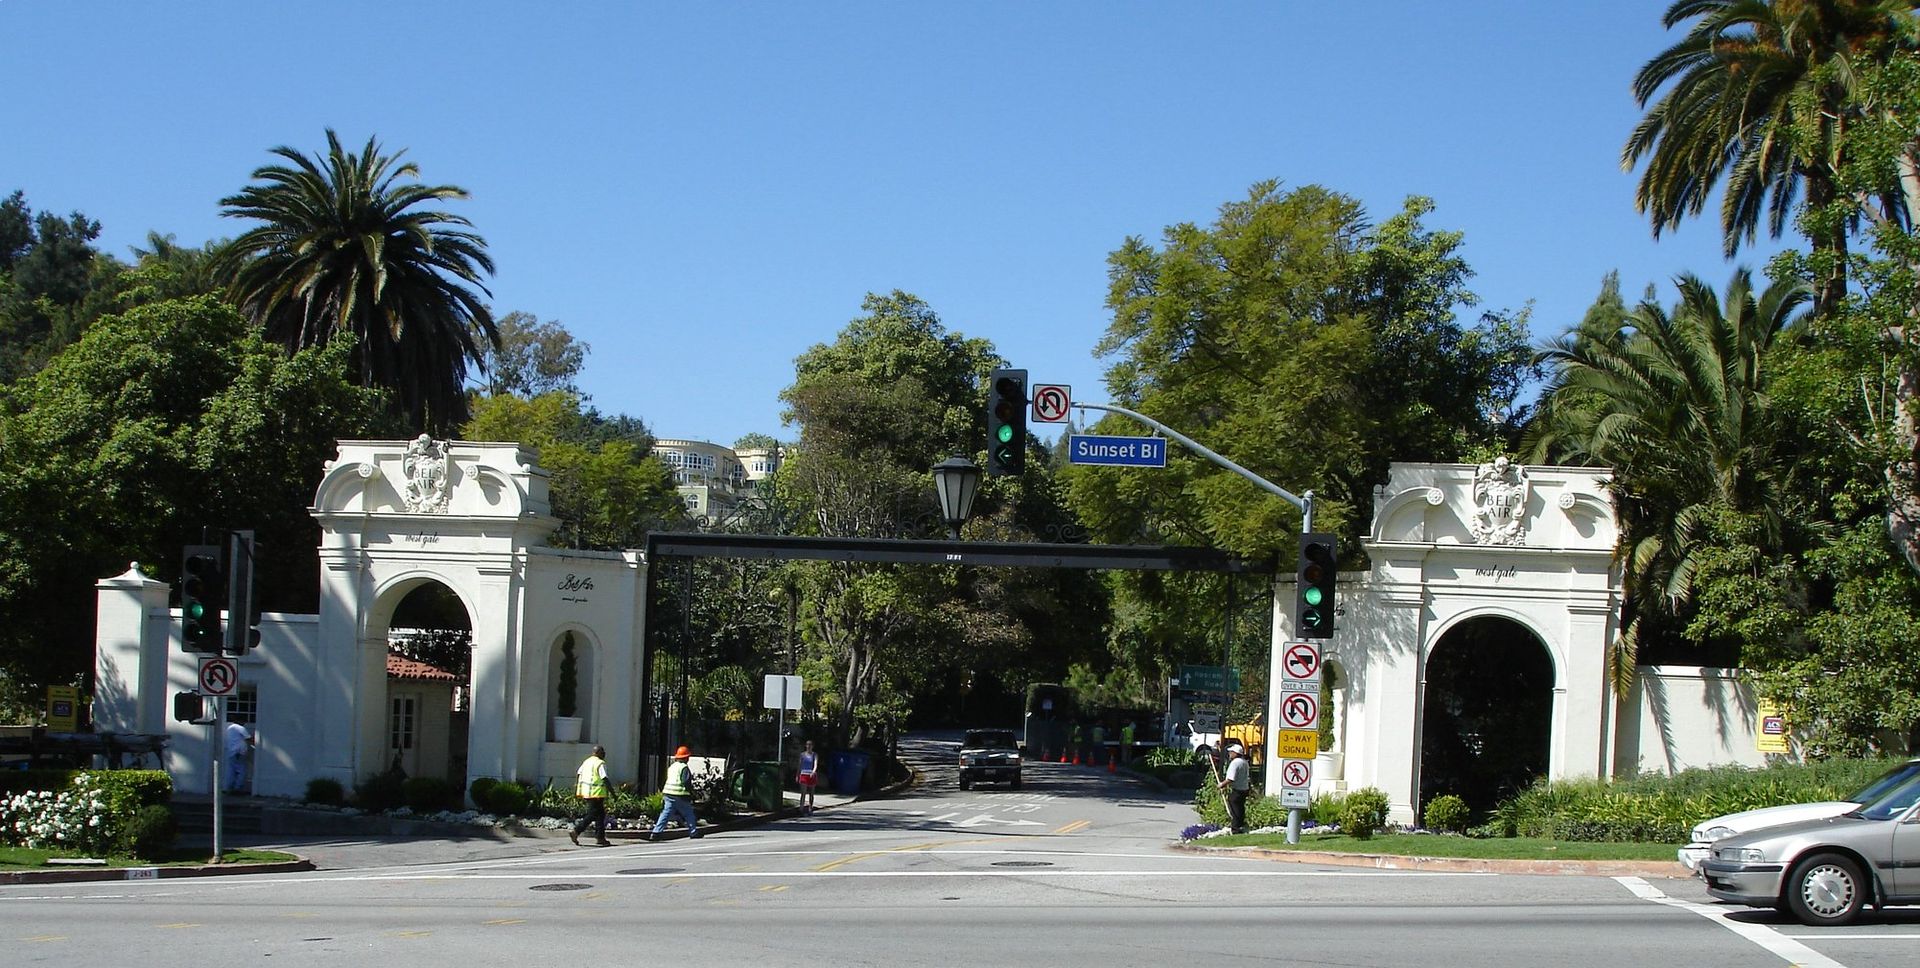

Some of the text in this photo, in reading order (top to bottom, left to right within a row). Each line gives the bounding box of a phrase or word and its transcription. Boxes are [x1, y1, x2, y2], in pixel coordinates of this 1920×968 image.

[1078, 441, 1157, 459] Sunset Bl
[414, 467, 436, 479] BEL
[417, 479, 435, 490] AIR
[1487, 494, 1512, 507] BEL
[1489, 507, 1511, 519] AIR
[1475, 564, 1516, 583] west gate
[1283, 734, 1312, 743] 3-WAY
[1283, 745, 1312, 755] SIGNAL
